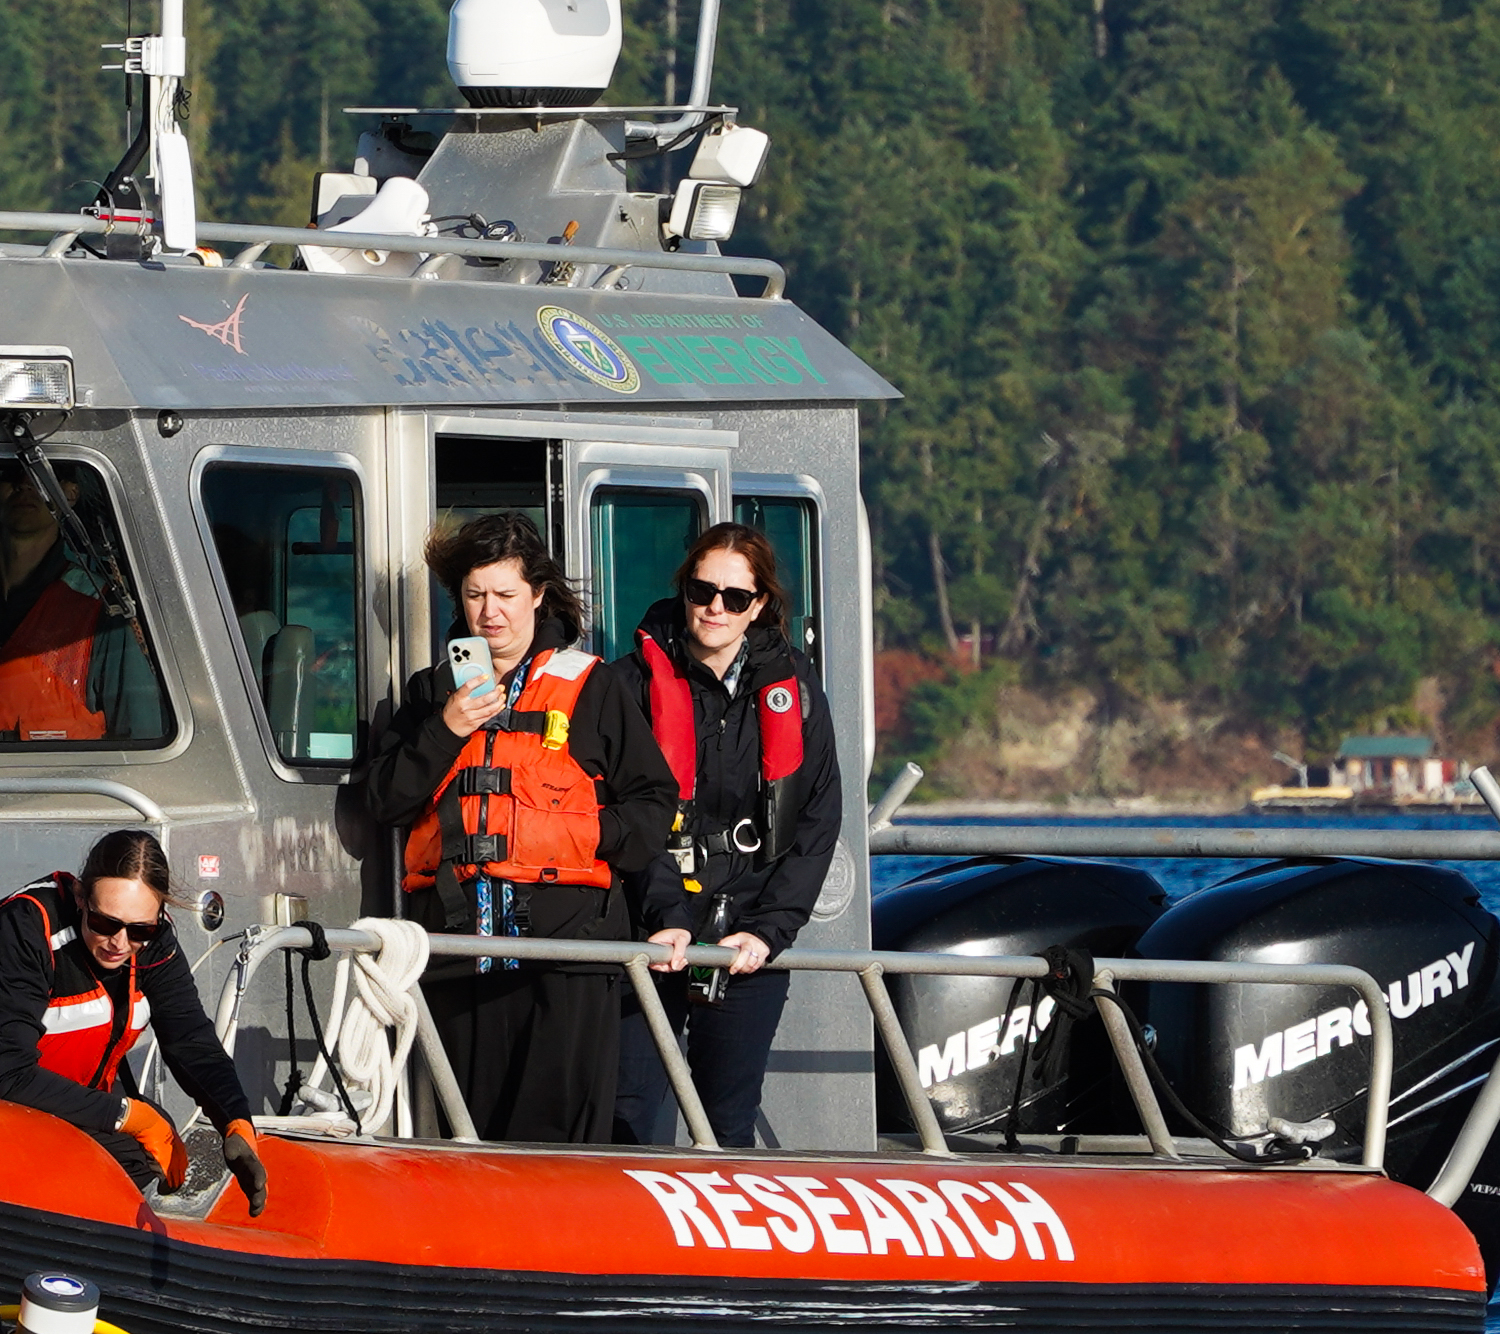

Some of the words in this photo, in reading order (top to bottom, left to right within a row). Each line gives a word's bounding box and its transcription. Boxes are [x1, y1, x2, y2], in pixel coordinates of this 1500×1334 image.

[596, 314, 635, 328] U.S.
[631, 314, 740, 328] DEPARTMENT
[741, 314, 764, 328] OF
[615, 335, 828, 385] ENERGY
[1233, 942, 1475, 1090] MERCURY
[622, 1169, 1075, 1261] RESEARCH
